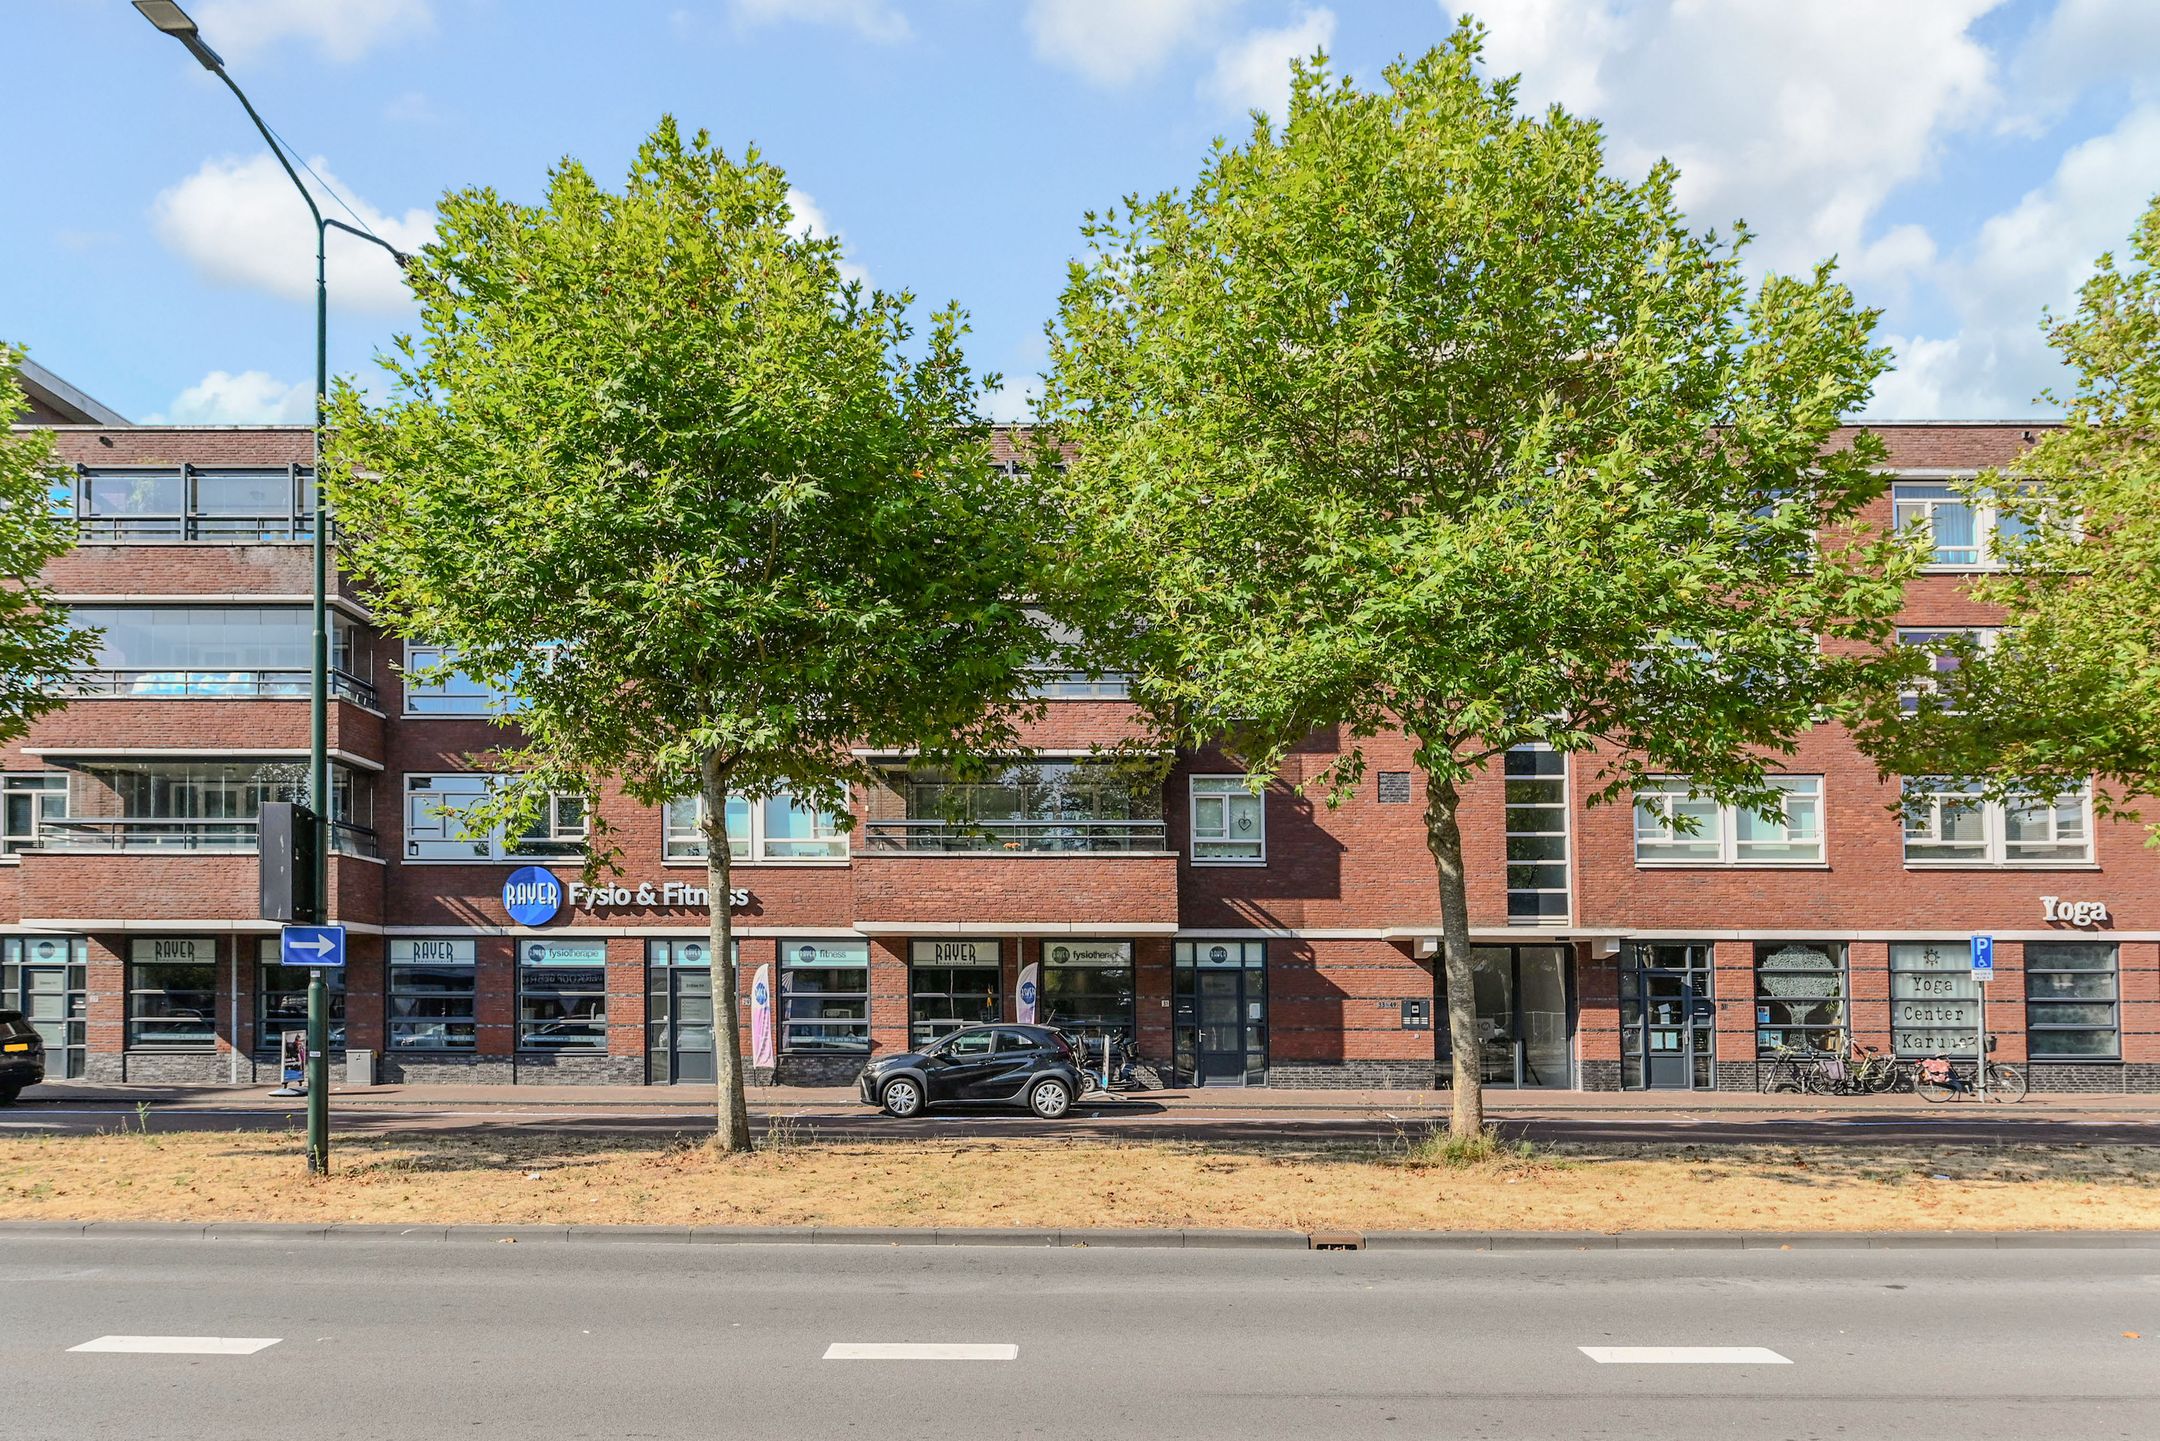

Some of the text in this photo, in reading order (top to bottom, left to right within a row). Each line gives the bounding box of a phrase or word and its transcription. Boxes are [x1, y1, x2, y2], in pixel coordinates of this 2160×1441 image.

[506, 881, 558, 910] RAYER
[568, 881, 750, 910] Fysio & Fitnss
[2039, 895, 2108, 926] Yoga
[155, 940, 195, 962] RAYER
[413, 941, 454, 963] RAYER
[819, 949, 847, 959] fitness
[935, 943, 976, 965] RAYER
[1976, 938, 1989, 956] P
[1912, 976, 1954, 995] Yoga
[1903, 1006, 1965, 1021] Center
